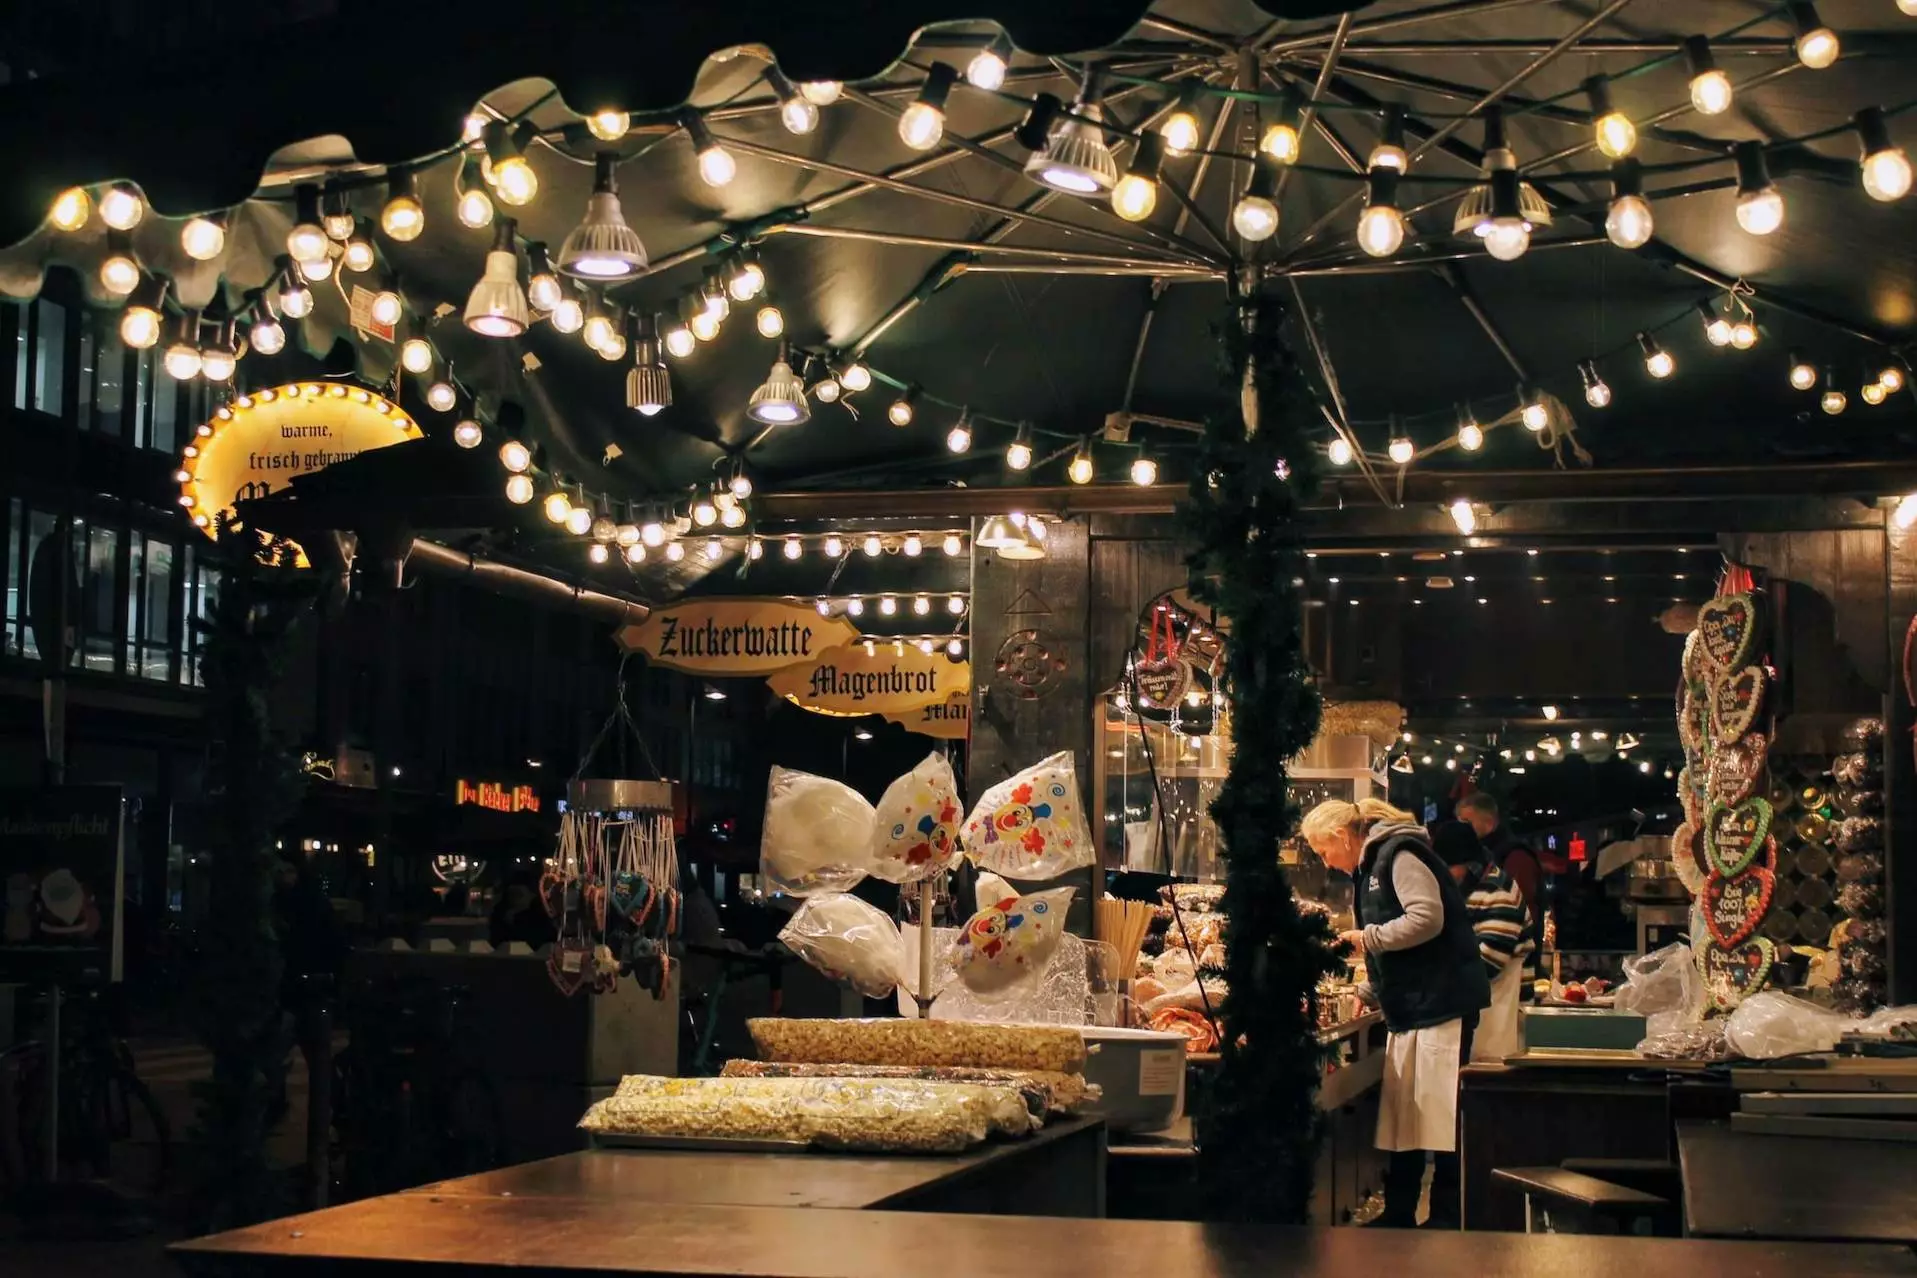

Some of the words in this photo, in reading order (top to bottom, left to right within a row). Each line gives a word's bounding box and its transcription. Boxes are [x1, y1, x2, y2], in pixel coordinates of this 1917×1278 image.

[249, 450, 300, 471] frisch
[659, 616, 812, 657] Zuckerwatte
[808, 664, 937, 700] Magenbrot
[1715, 908, 1746, 929] Single
